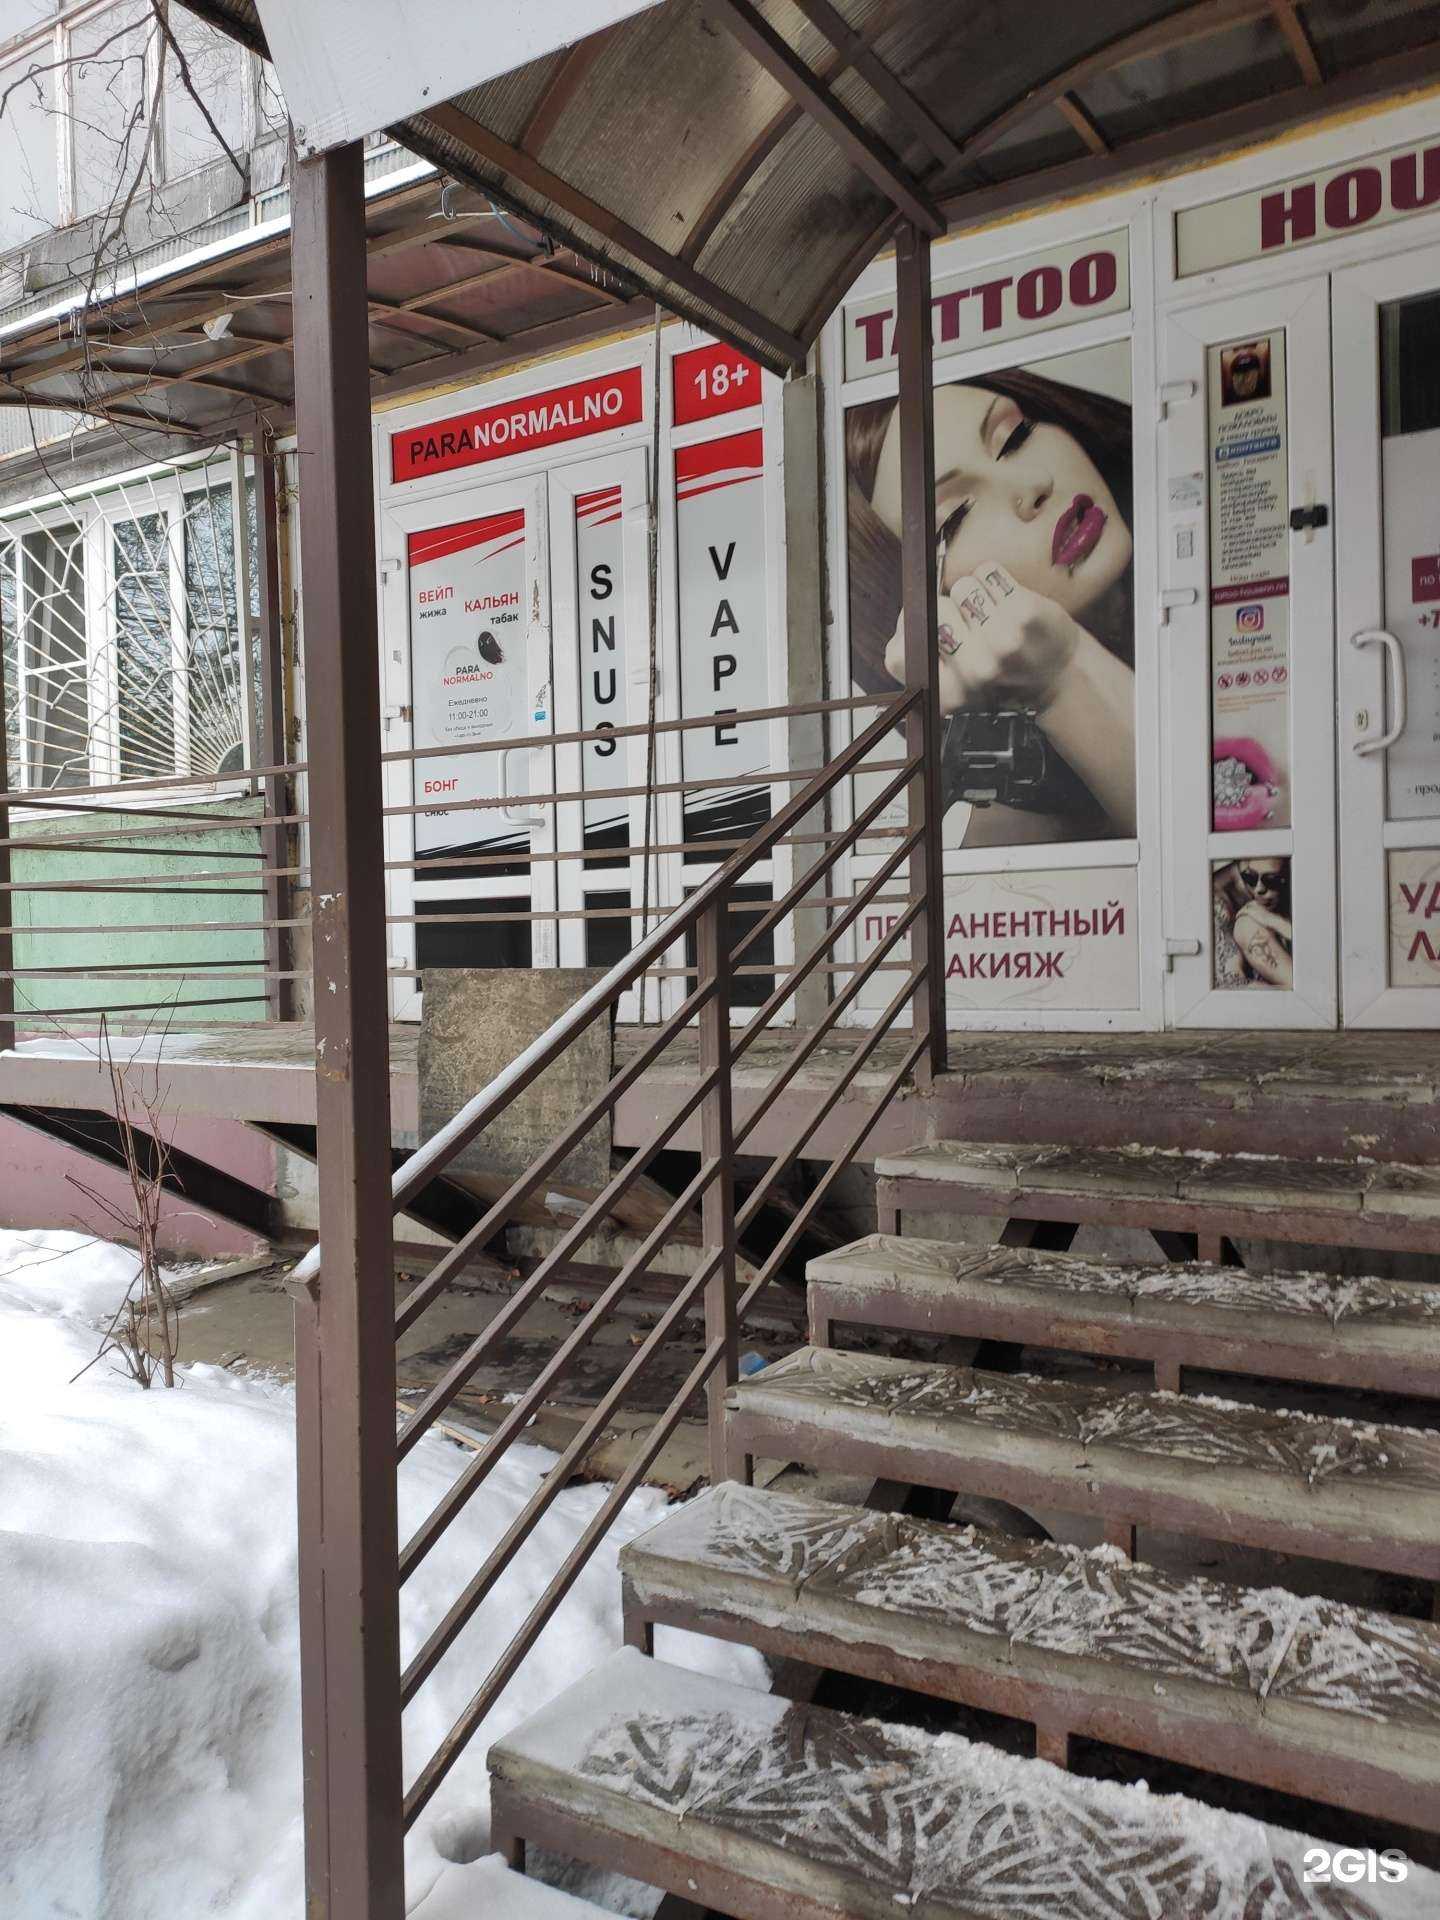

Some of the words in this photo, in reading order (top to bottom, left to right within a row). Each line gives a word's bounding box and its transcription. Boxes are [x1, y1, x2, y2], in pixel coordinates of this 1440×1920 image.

[1262, 147, 1440, 250] HOU
[855, 252, 1117, 362] TTTOO
[695, 362, 749, 401] 18+
[410, 387, 623, 465] PARANORMALNO
[418, 584, 454, 604] ВЕЙП
[464, 591, 519, 614] КАЛЬЯН
[419, 607, 447, 620] жижа
[490, 612, 520, 625] табак
[708, 541, 740, 747] VAPE
[455, 664, 480, 676] PARA
[590, 564, 617, 757] SNUS
[443, 671, 494, 687] NORMALNO
[448, 708, 489, 721] 11:00-21:00
[424, 778, 459, 793] БОНГ
[945, 951, 1065, 979] АКИЯЖ
